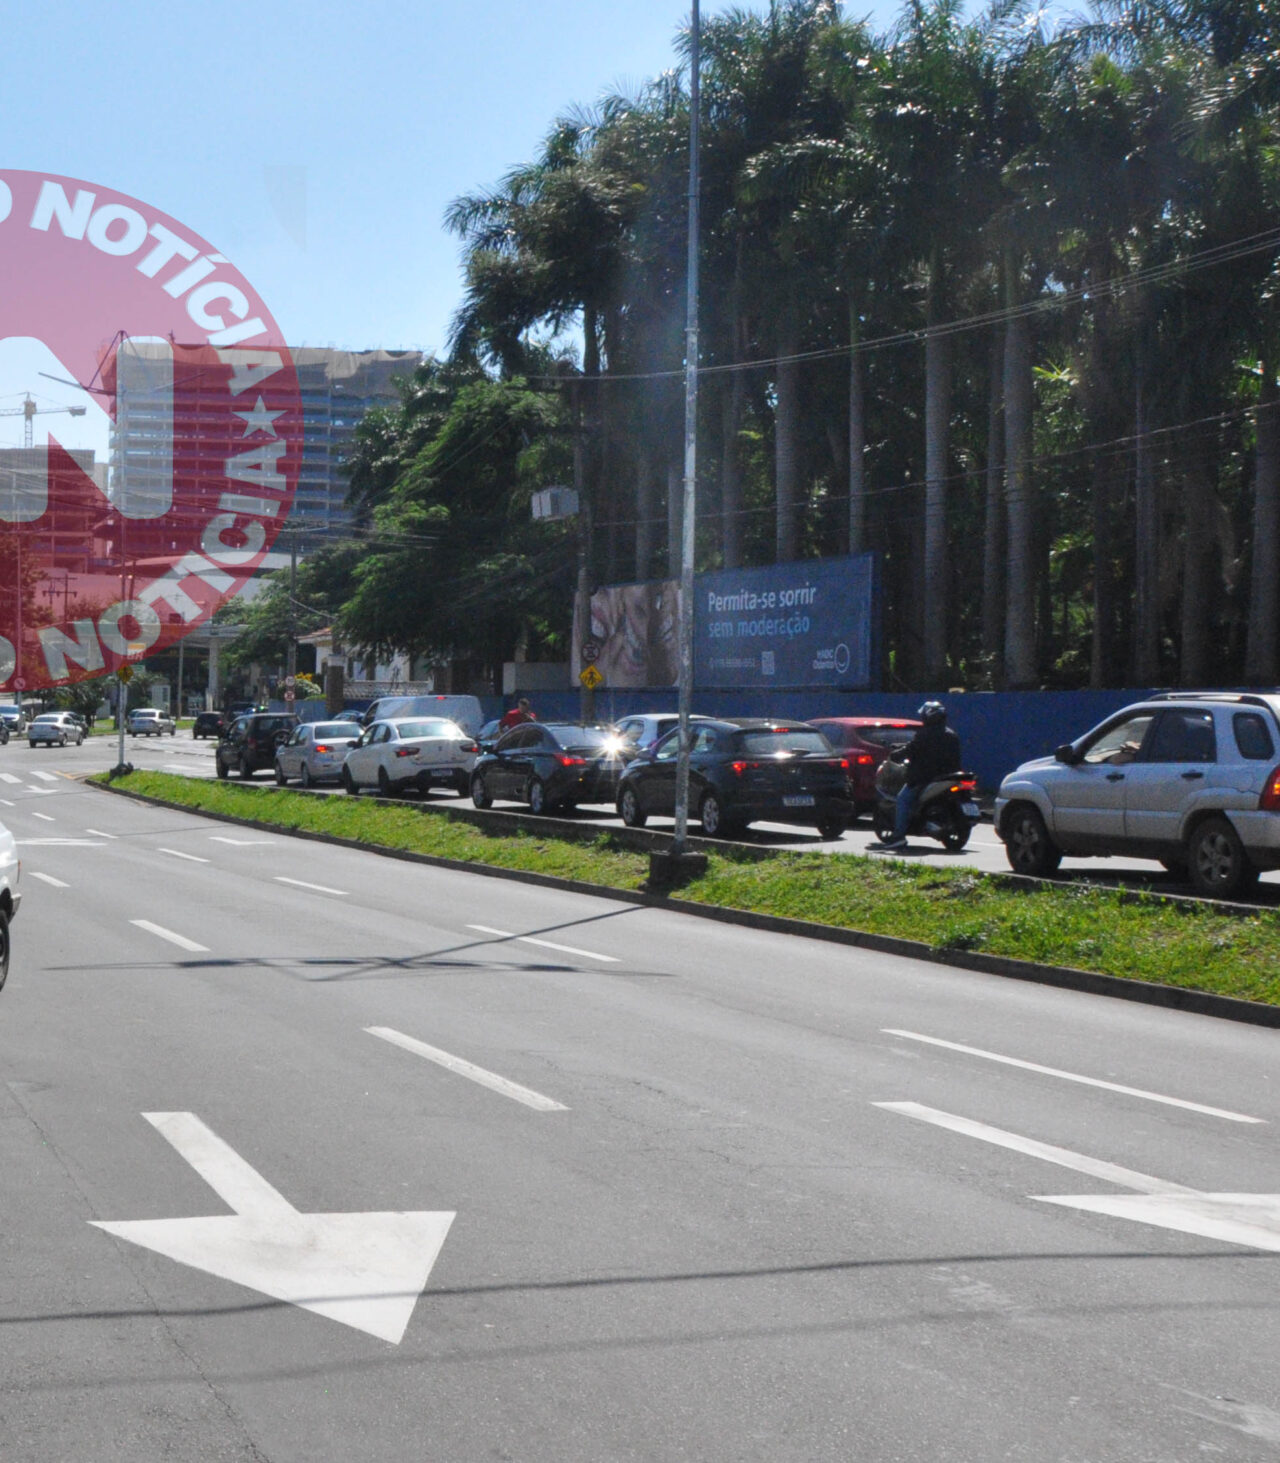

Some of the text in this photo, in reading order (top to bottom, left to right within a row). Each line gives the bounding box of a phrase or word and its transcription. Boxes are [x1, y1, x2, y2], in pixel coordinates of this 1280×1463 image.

[708, 581, 817, 613] Permita-se sorrir
[708, 612, 810, 640] sem moderação
